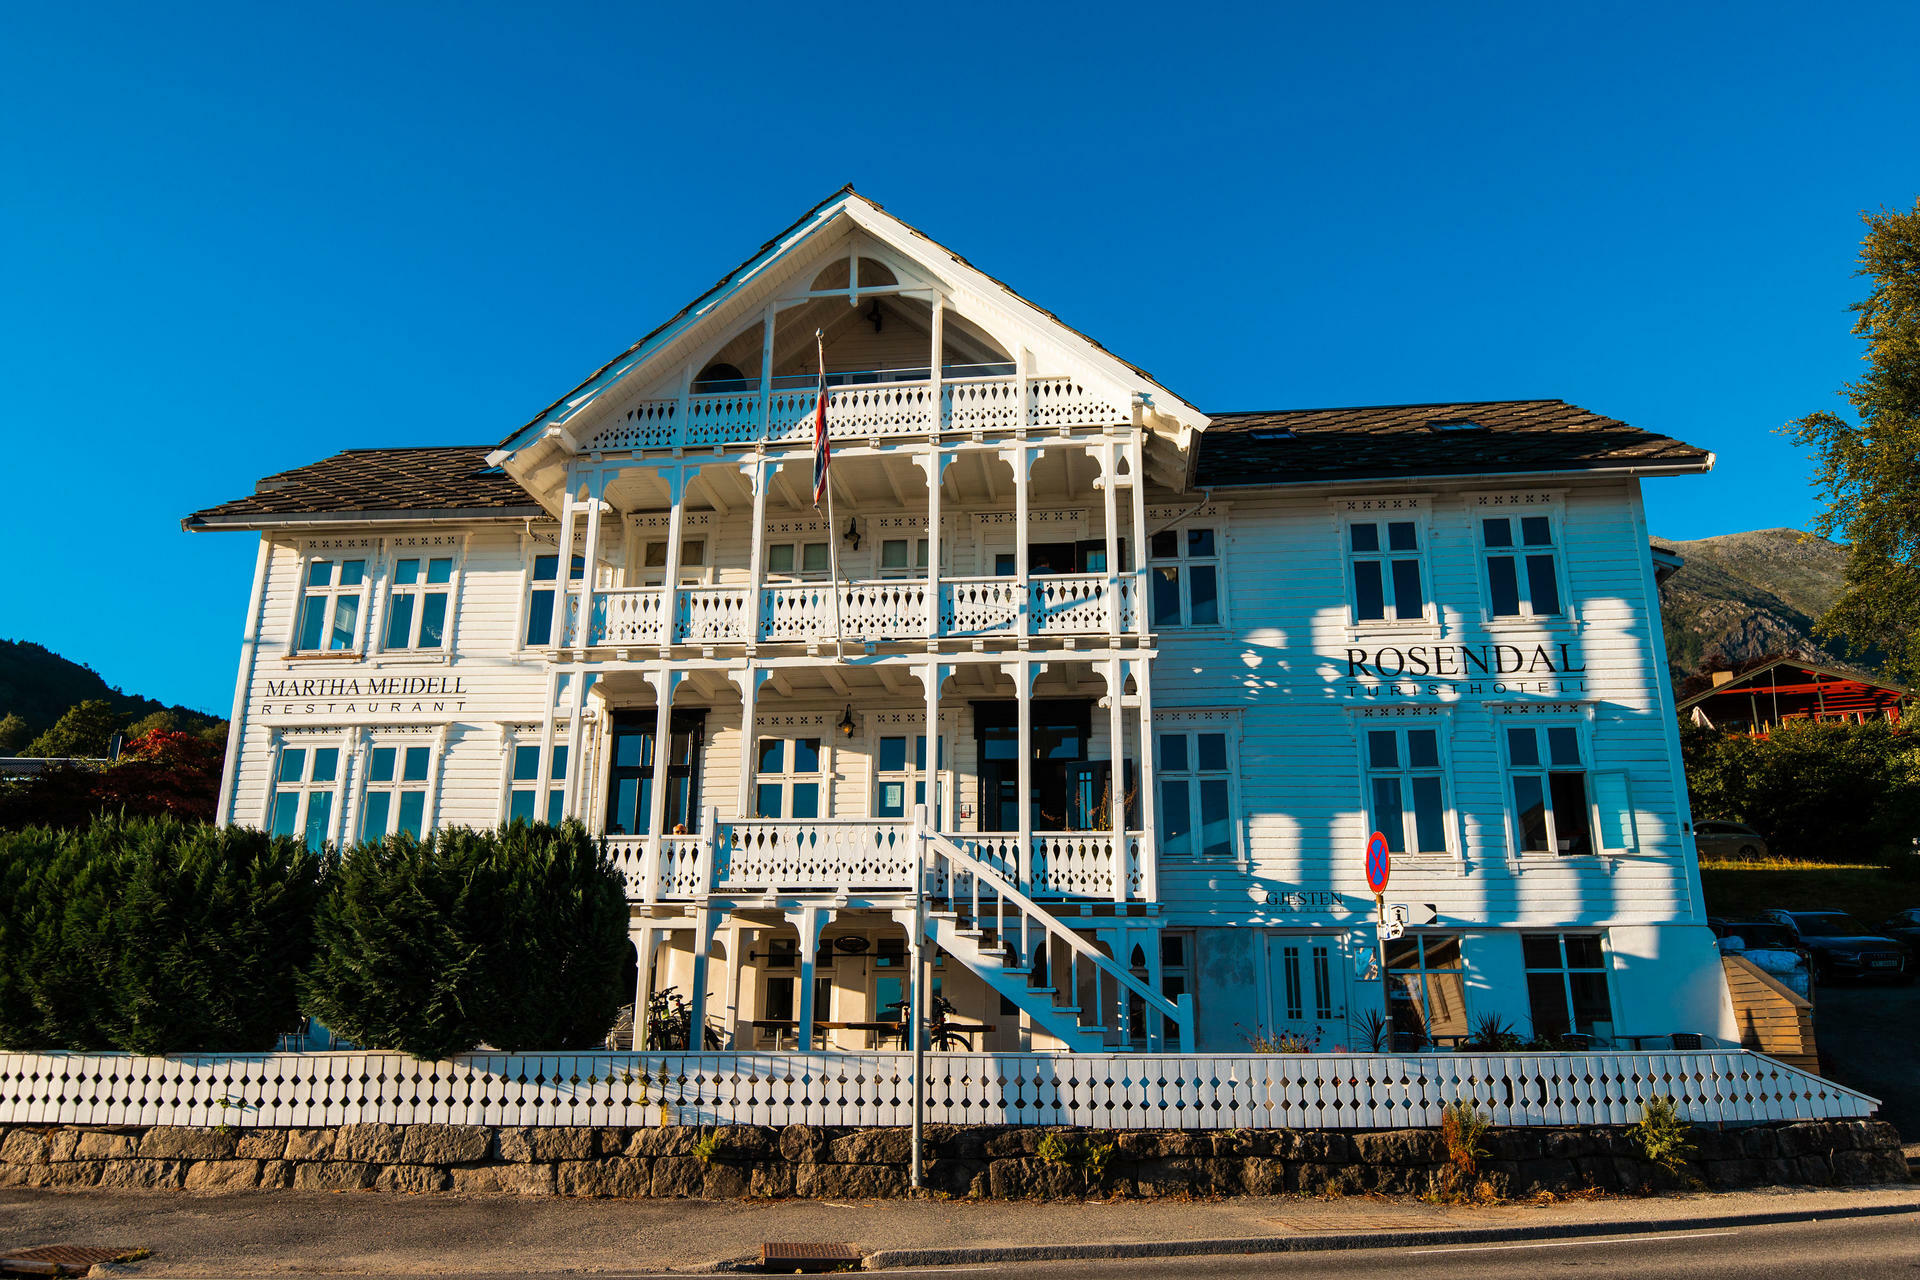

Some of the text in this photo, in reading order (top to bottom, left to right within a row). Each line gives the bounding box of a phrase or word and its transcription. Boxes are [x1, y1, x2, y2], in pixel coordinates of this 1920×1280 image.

[1344, 643, 1587, 677] ROSENDAL
[266, 677, 467, 697] MARTHA MEIDELL
[1347, 682, 1590, 697] TURISTHOTELL
[262, 702, 467, 714] RESTAURANT
[1266, 892, 1343, 905] GJESTEN
